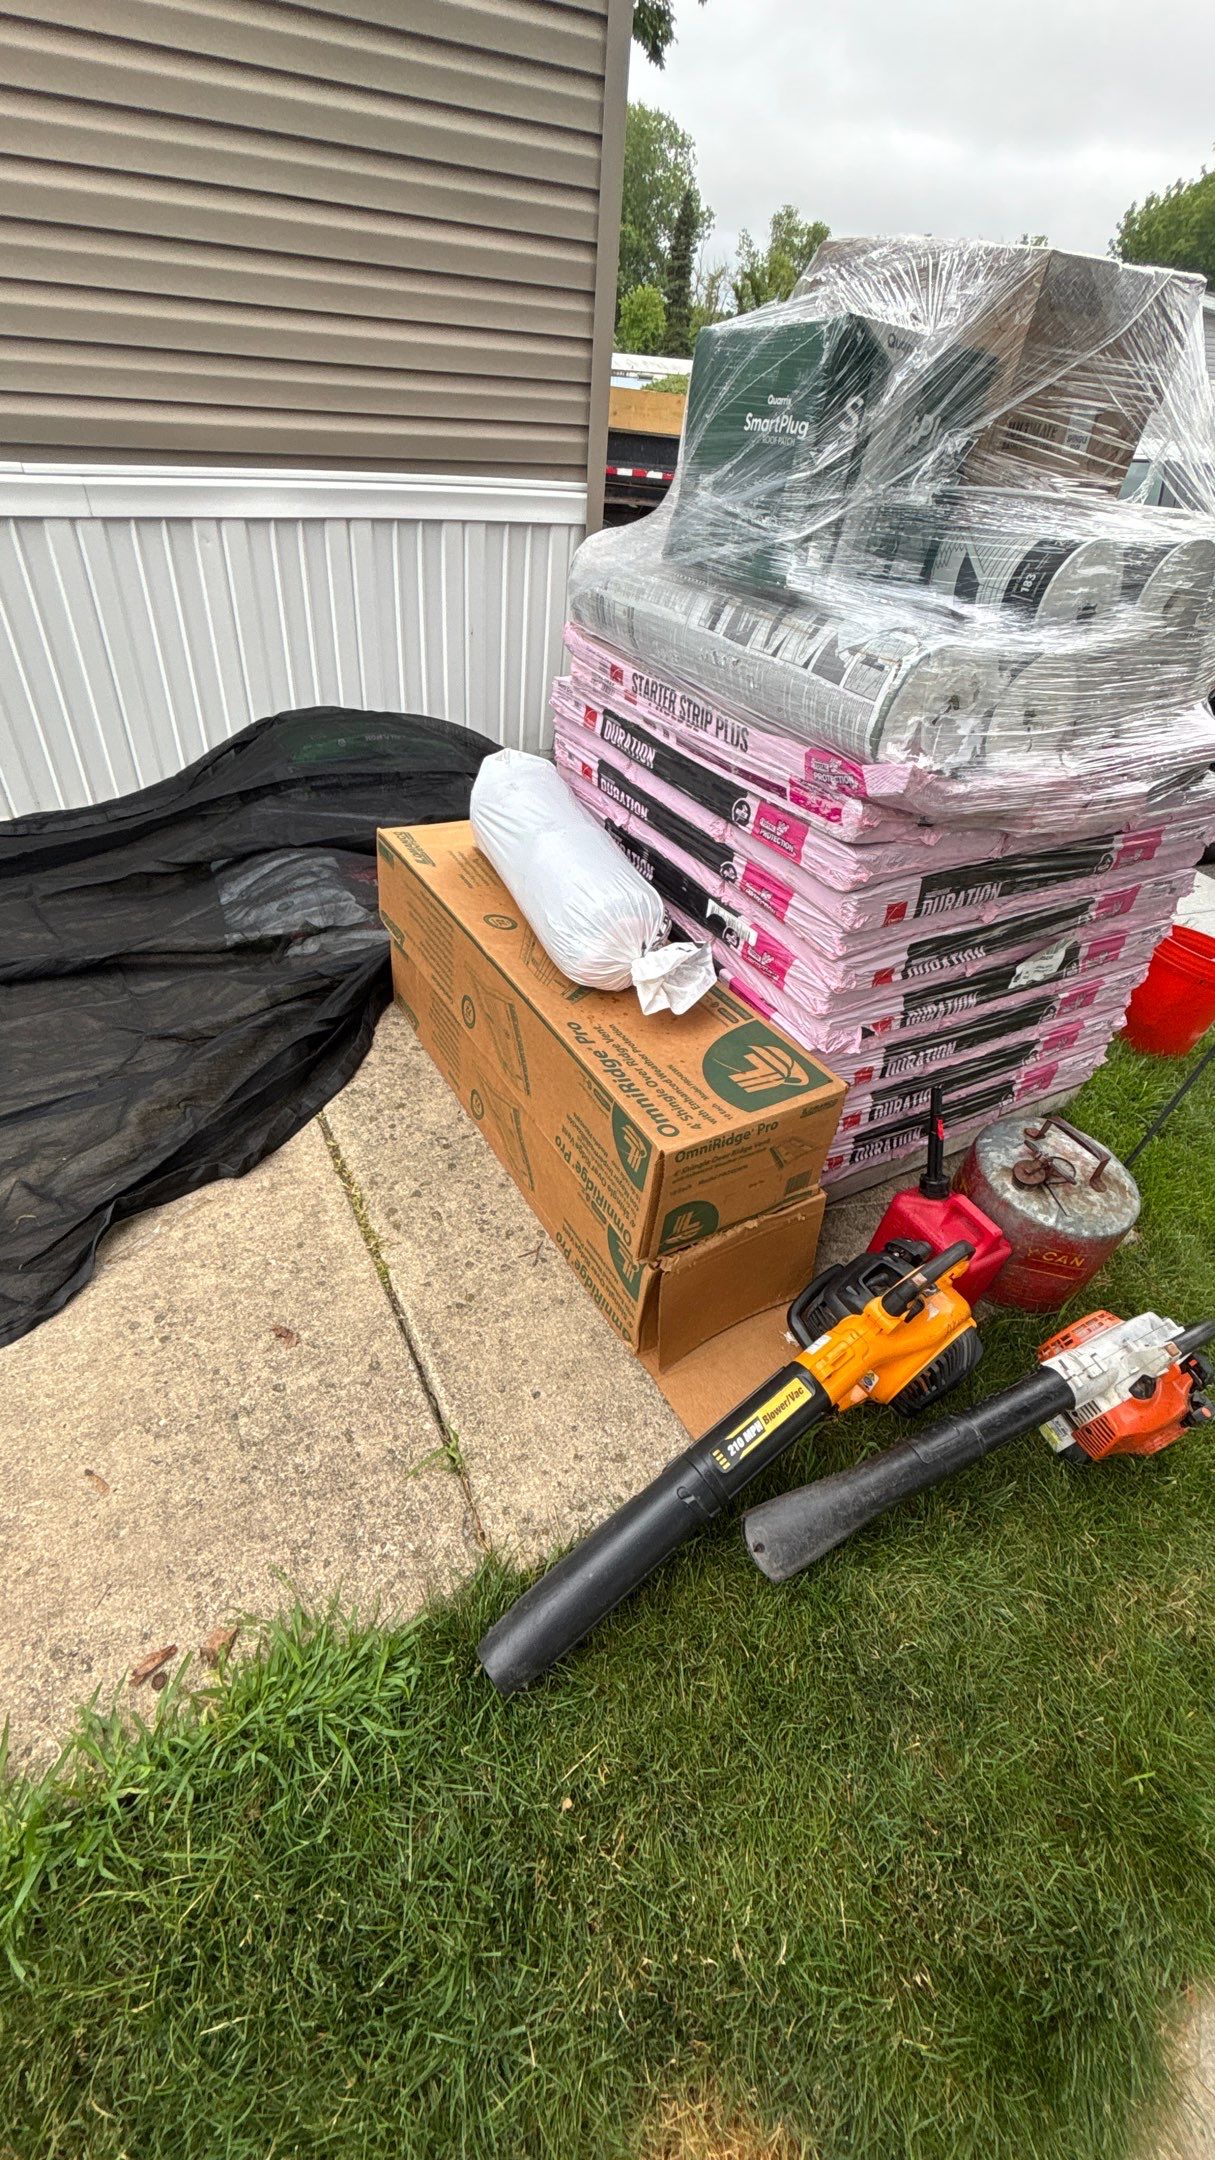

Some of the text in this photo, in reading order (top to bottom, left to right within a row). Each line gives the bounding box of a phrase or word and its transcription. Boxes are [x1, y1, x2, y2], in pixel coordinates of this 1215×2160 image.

[743, 412, 810, 440] SmartPlug
[631, 672, 677, 715] STARTER
[680, 694, 713, 732] STRIP
[715, 714, 750, 753] PLUS
[603, 719, 657, 769] DURATION
[600, 776, 650, 821] DURATION
[760, 829, 796, 855] PROTECTION
[920, 882, 1003, 918] DURATION
[905, 990, 980, 1027] DURATION
[566, 1021, 596, 1045] Pro
[592, 1023, 615, 1045] Vent
[612, 1043, 639, 1067] Ridge
[885, 1041, 957, 1078] DURATION
[608, 1023, 719, 1125] with Enhanced Weather Protection
[634, 1066, 659, 1089] Over
[593, 1049, 681, 1138] OmniRidge
[655, 1087, 695, 1122] Shingle
[873, 1085, 933, 1120] DURATIO
[554, 1135, 572, 1163] Pro
[674, 1120, 779, 1164] OmniRidge Pro
[854, 1125, 923, 1163] DURATION
[575, 1160, 632, 1247] OmniRidge
[556, 1231, 571, 1260] Pro
[1042, 1251, 1085, 1267] CAN
[574, 1258, 632, 1343] OmniRidge
[726, 1386, 805, 1457] 210 MPH Blower/Vac
